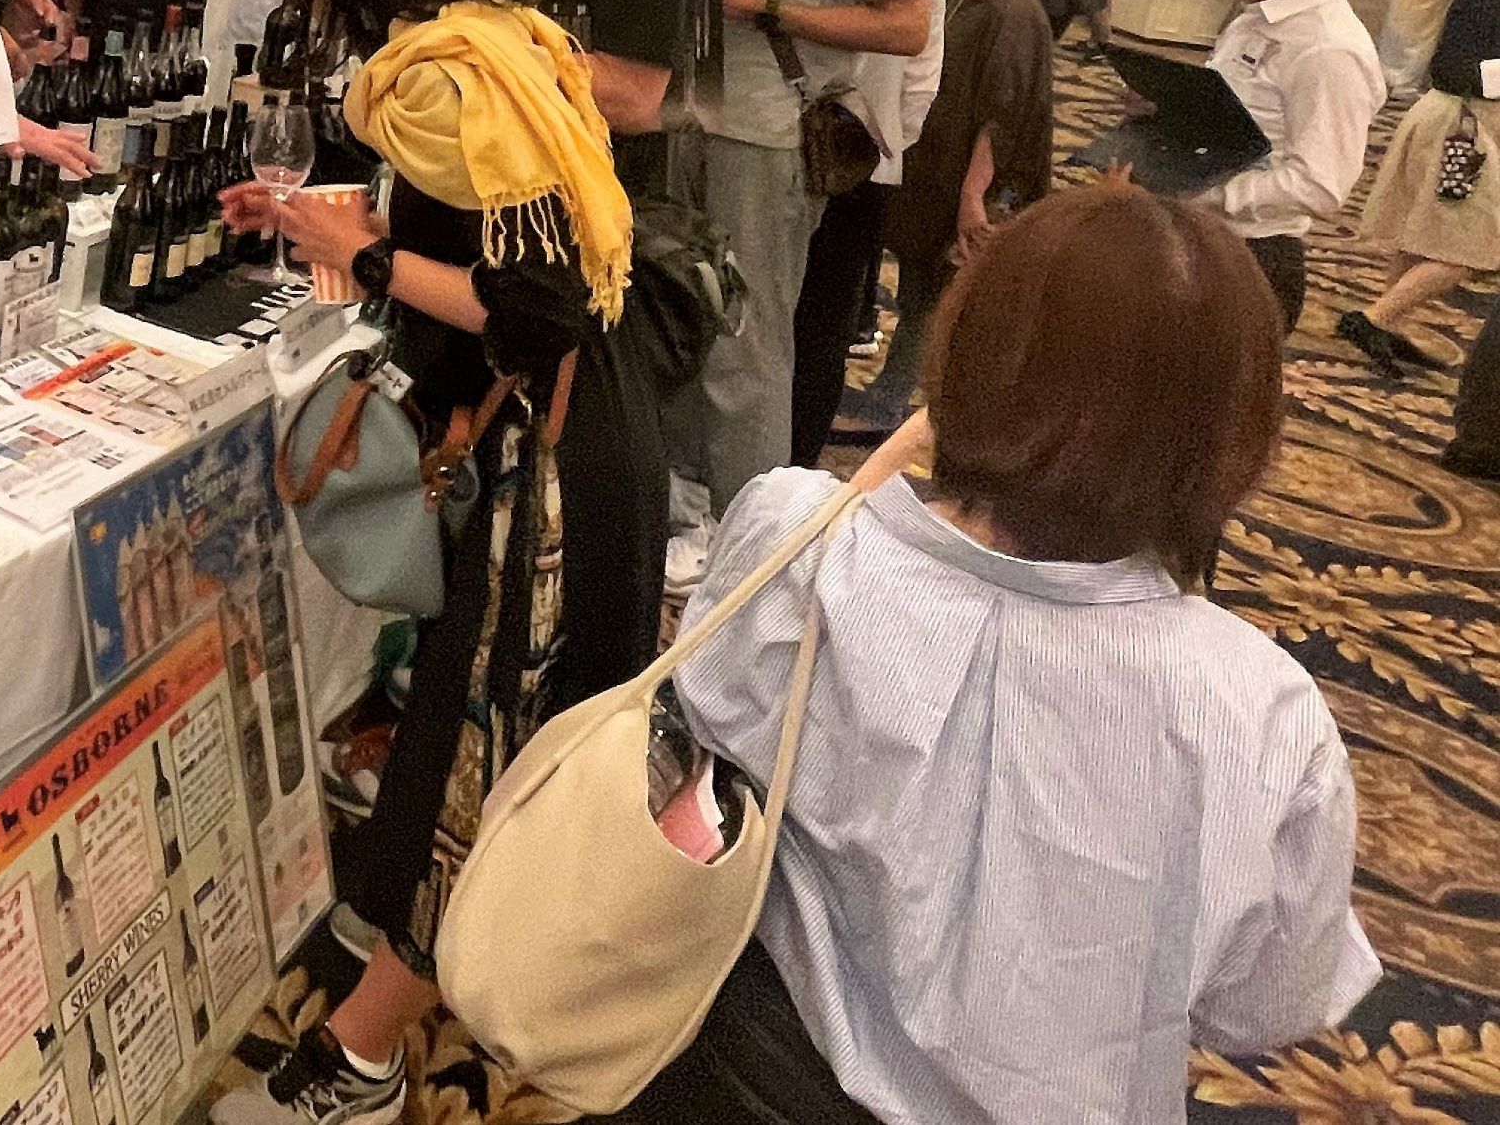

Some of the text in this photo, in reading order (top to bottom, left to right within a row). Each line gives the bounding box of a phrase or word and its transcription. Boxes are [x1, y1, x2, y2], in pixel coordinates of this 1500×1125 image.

[24, 677, 172, 818] OSBORNE
[69, 952, 124, 1020] SHERRY
[122, 905, 167, 959] WINES
